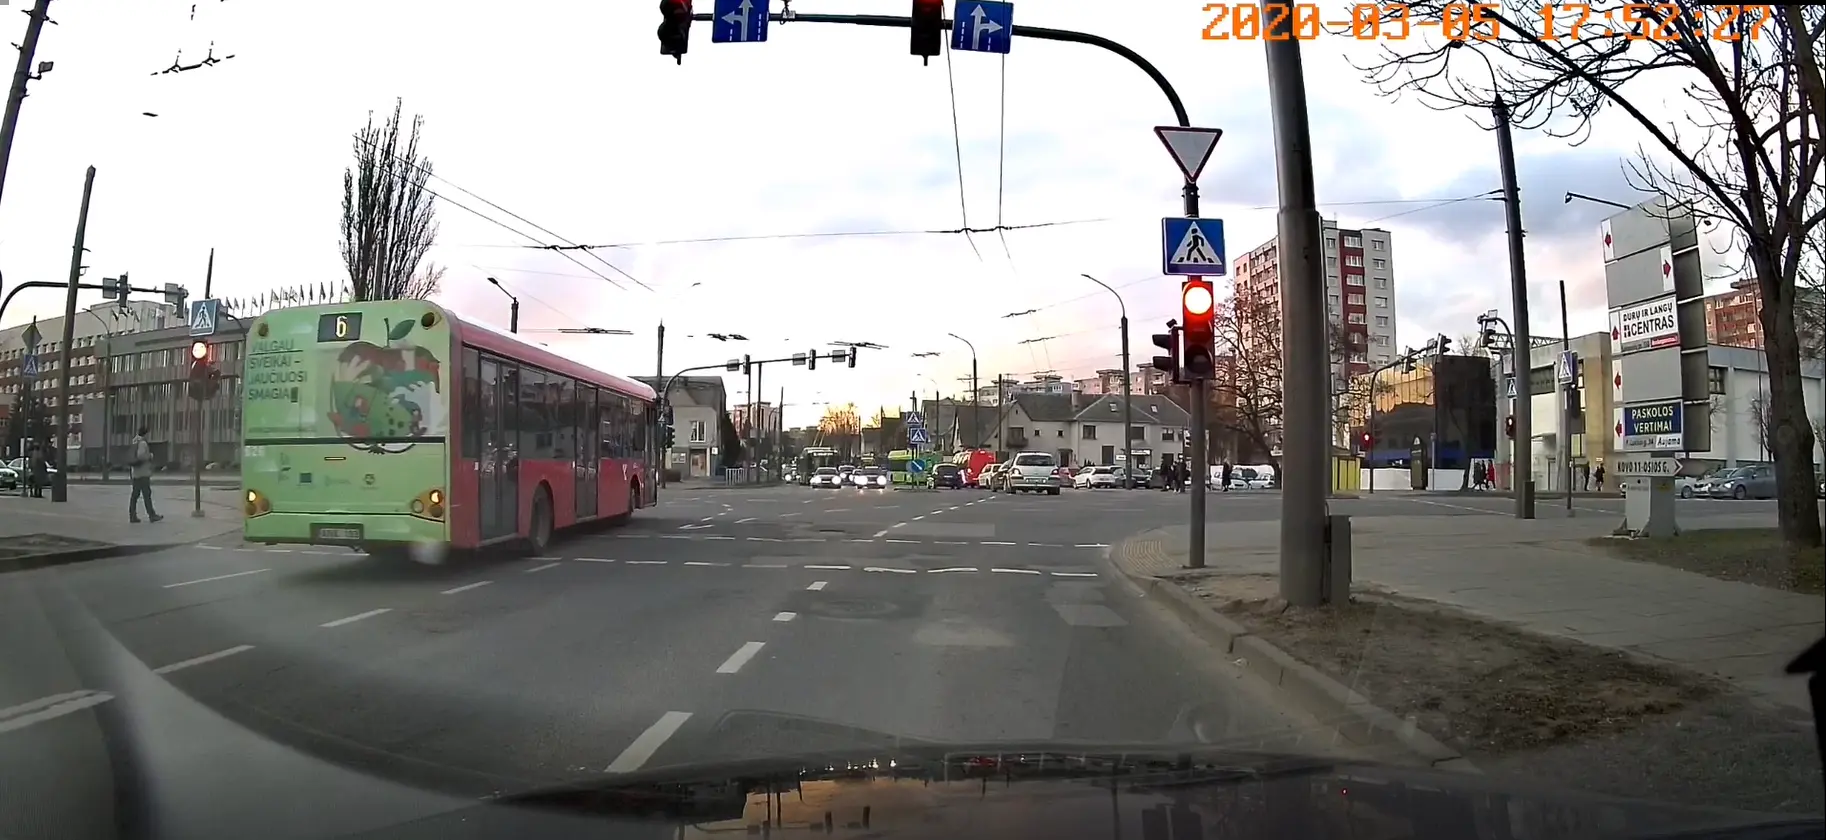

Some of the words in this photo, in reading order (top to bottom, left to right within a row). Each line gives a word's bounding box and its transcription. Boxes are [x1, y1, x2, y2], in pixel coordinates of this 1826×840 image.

[1641, 308, 1649, 317] IR
[335, 315, 348, 338] 6
[1631, 314, 1674, 336] CENTRAS
[251, 338, 294, 352] VALGAU
[249, 355, 291, 369] SVEIKAI
[248, 369, 307, 385] JAUČIUOSI
[248, 387, 298, 403] SMAGIA
[1631, 405, 1674, 420] PASKOLOS
[1633, 420, 1673, 433] VERTIMAI
